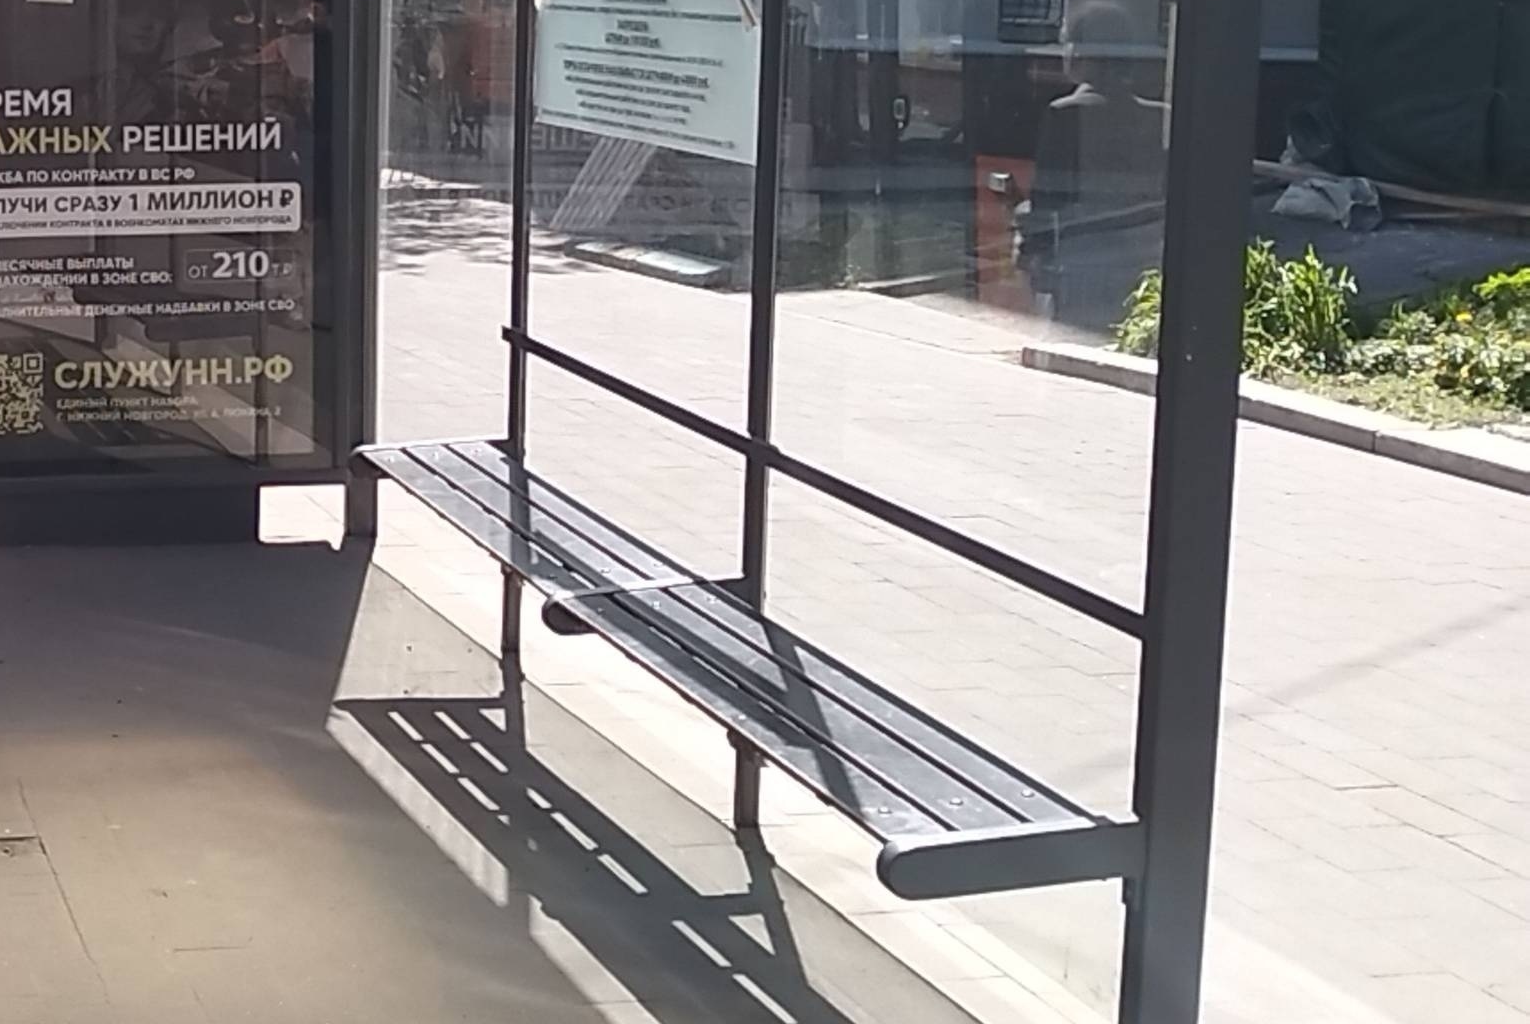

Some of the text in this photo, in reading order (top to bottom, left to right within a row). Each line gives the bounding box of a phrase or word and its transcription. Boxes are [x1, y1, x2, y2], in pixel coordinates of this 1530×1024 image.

[123, 117, 281, 153] РЕШЕНИЙ
[26, 169, 49, 183] ПО
[52, 167, 136, 183] КОНТРАКТУ
[138, 167, 148, 181] В
[150, 166, 171, 180] ВС
[174, 165, 196, 180] РФ
[54, 194, 122, 213] СРАЗУ
[128, 192, 139, 211] 1
[147, 189, 274, 211] МИЛЛИОН
[50, 218, 104, 229] КОНТРАКТА
[67, 256, 134, 272] ВЫПЛАТЫ
[188, 264, 209, 279] ОТ
[212, 249, 270, 279] 210
[90, 272, 100, 285] В
[102, 271, 138, 285] ЗОНЕ
[84, 302, 154, 318] ДЕНЕЖНЫЕ
[155, 300, 222, 315] НАДБАВКИ
[223, 300, 232, 313] В
[234, 299, 266, 313] ЗОНЕ
[268, 297, 295, 312] СВО
[54, 354, 293, 389] СЛУЖУНН.РФ
